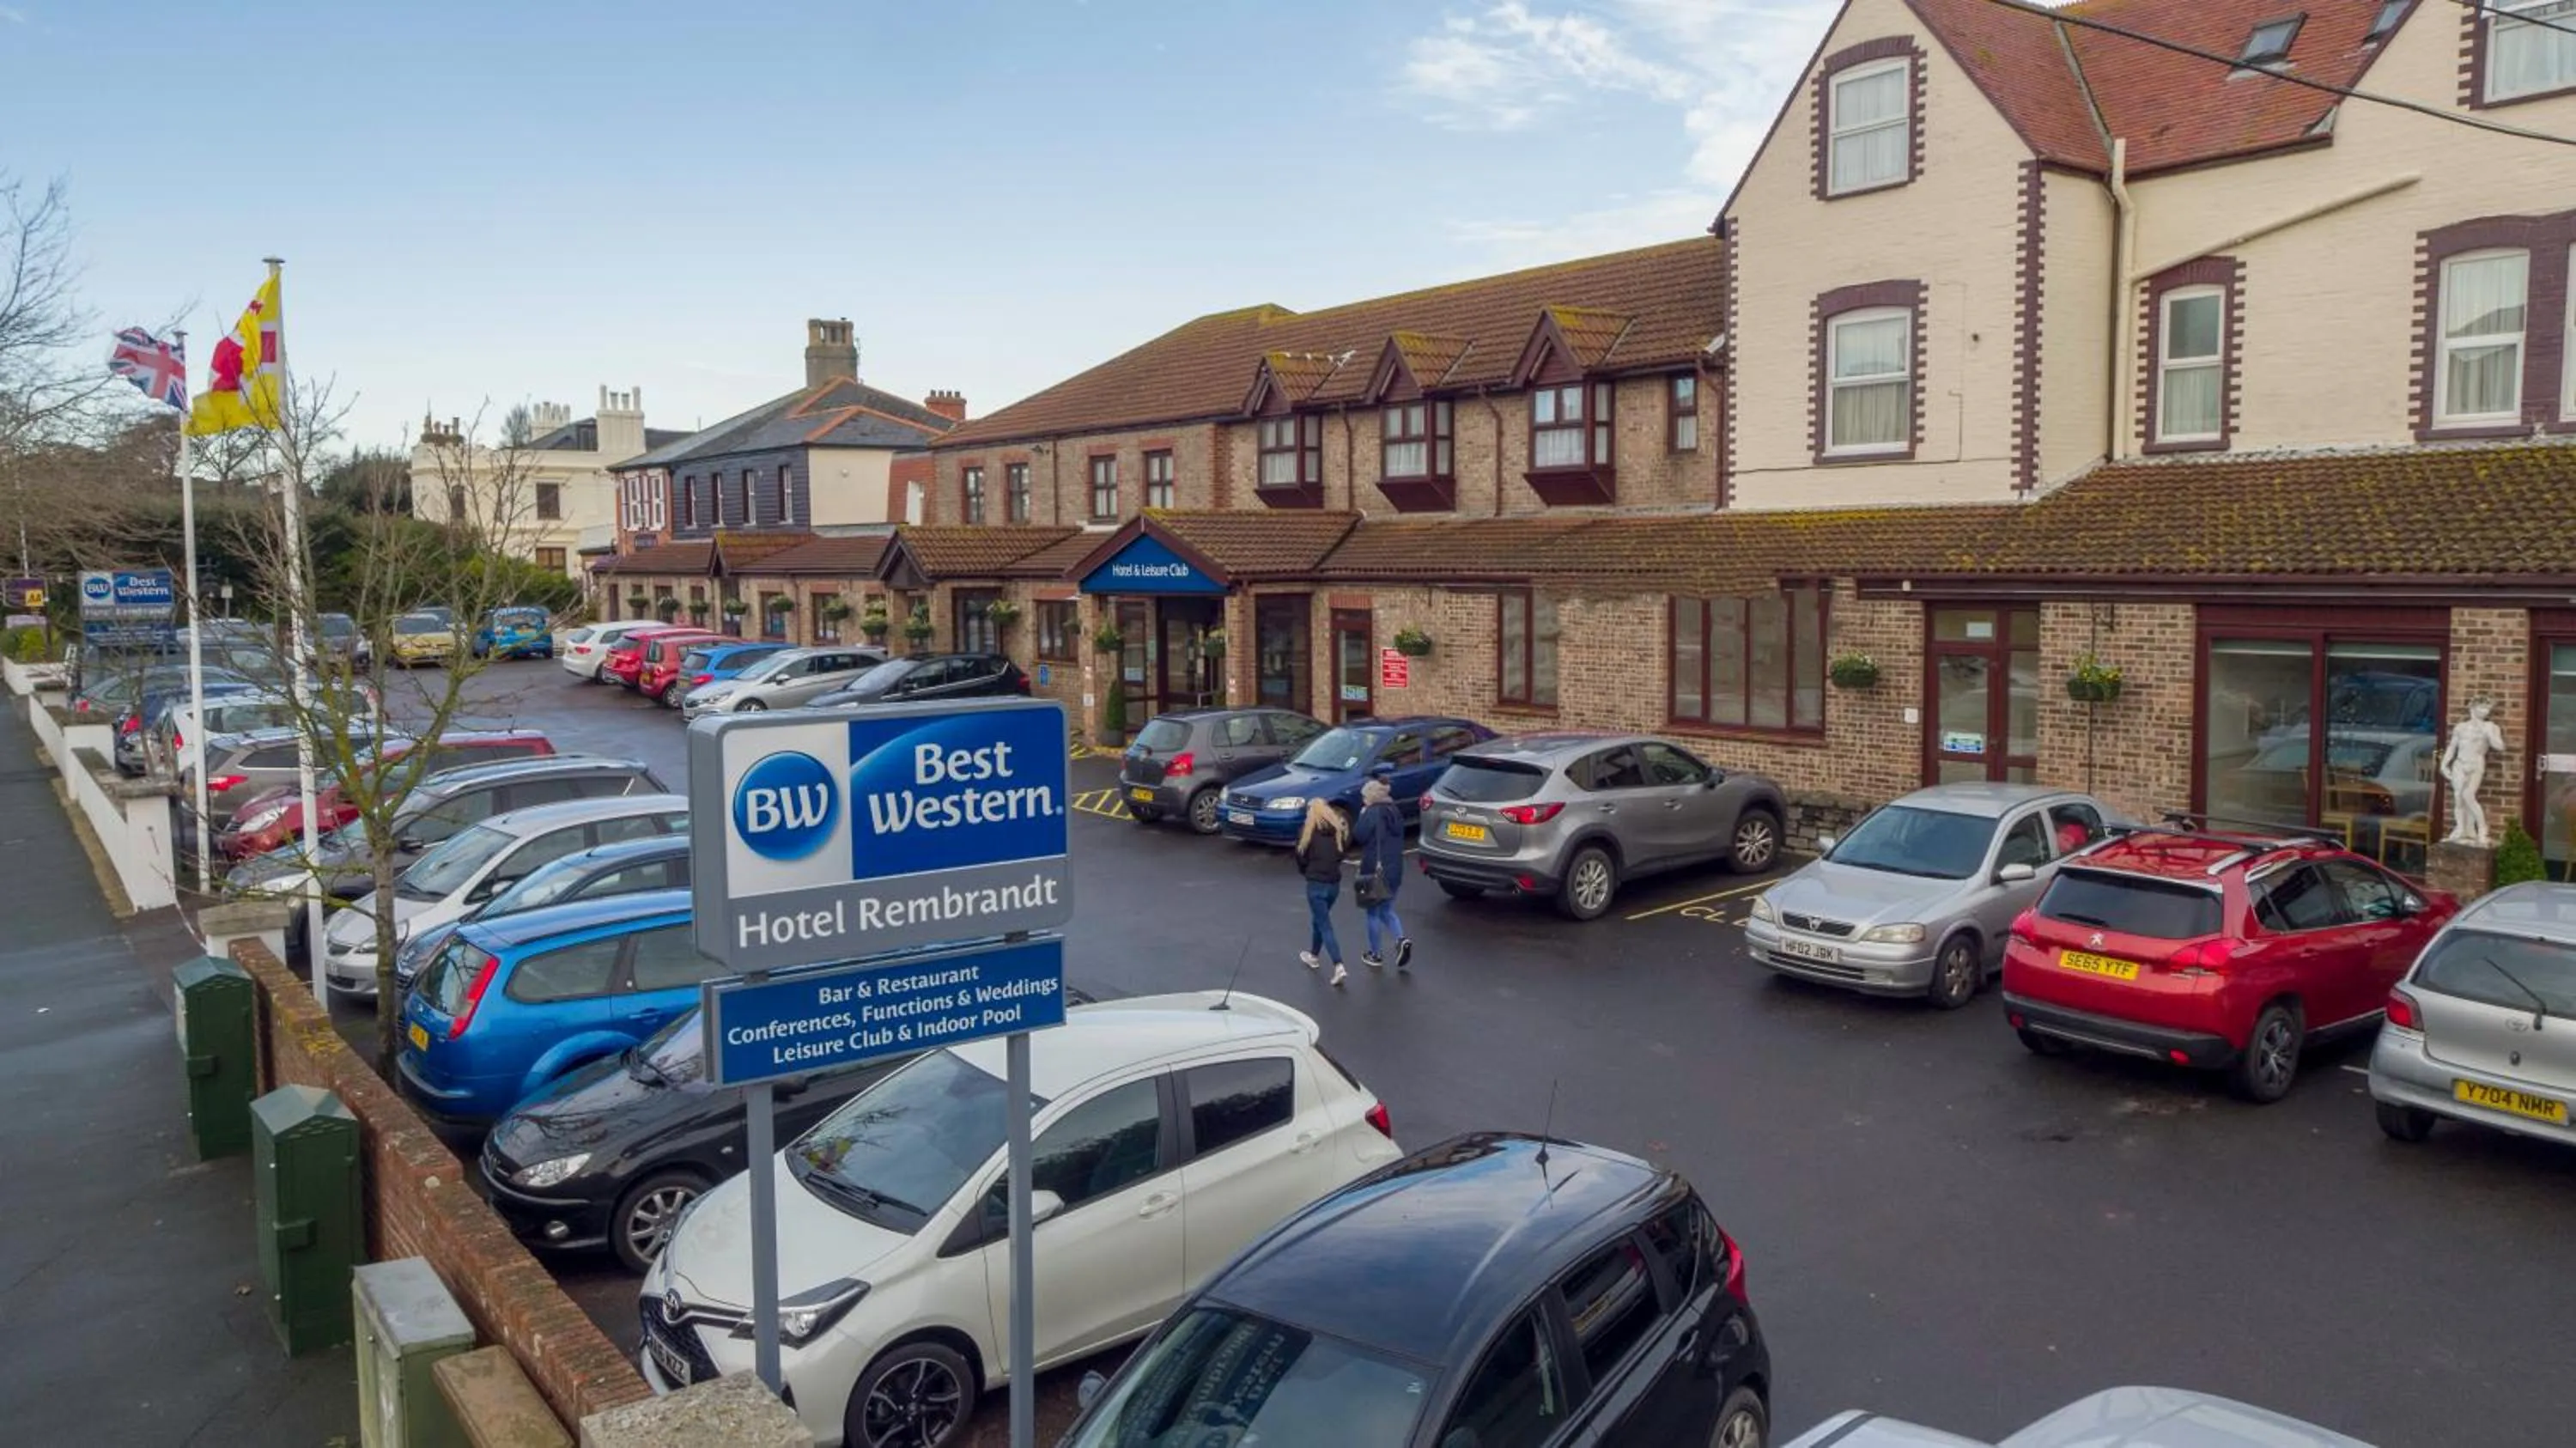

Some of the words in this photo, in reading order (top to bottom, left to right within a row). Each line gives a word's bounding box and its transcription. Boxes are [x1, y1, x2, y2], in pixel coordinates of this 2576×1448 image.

[1112, 563, 1133, 576] Hotel
[1134, 563, 1140, 576] &
[1141, 563, 1168, 576] Leisure
[1169, 563, 1189, 576] Club
[914, 741, 1013, 785] Best
[746, 782, 829, 833] BW
[738, 900, 846, 950] Hotel
[860, 873, 1058, 931] Rembrandt
[818, 986, 853, 1006] Bar
[858, 982, 872, 999] &
[878, 965, 980, 995] Restaurant
[727, 1010, 857, 1046] Conferences,
[862, 995, 953, 1024] Functions
[958, 991, 972, 1007] &
[975, 976, 1059, 1004] Weddings
[773, 1039, 845, 1065] Leisure
[849, 1028, 893, 1050] Club
[897, 1025, 913, 1042] &
[918, 1015, 978, 1039] Indoor
[982, 1004, 1022, 1026] Pool
[2466, 1082, 2512, 1106] Y704
